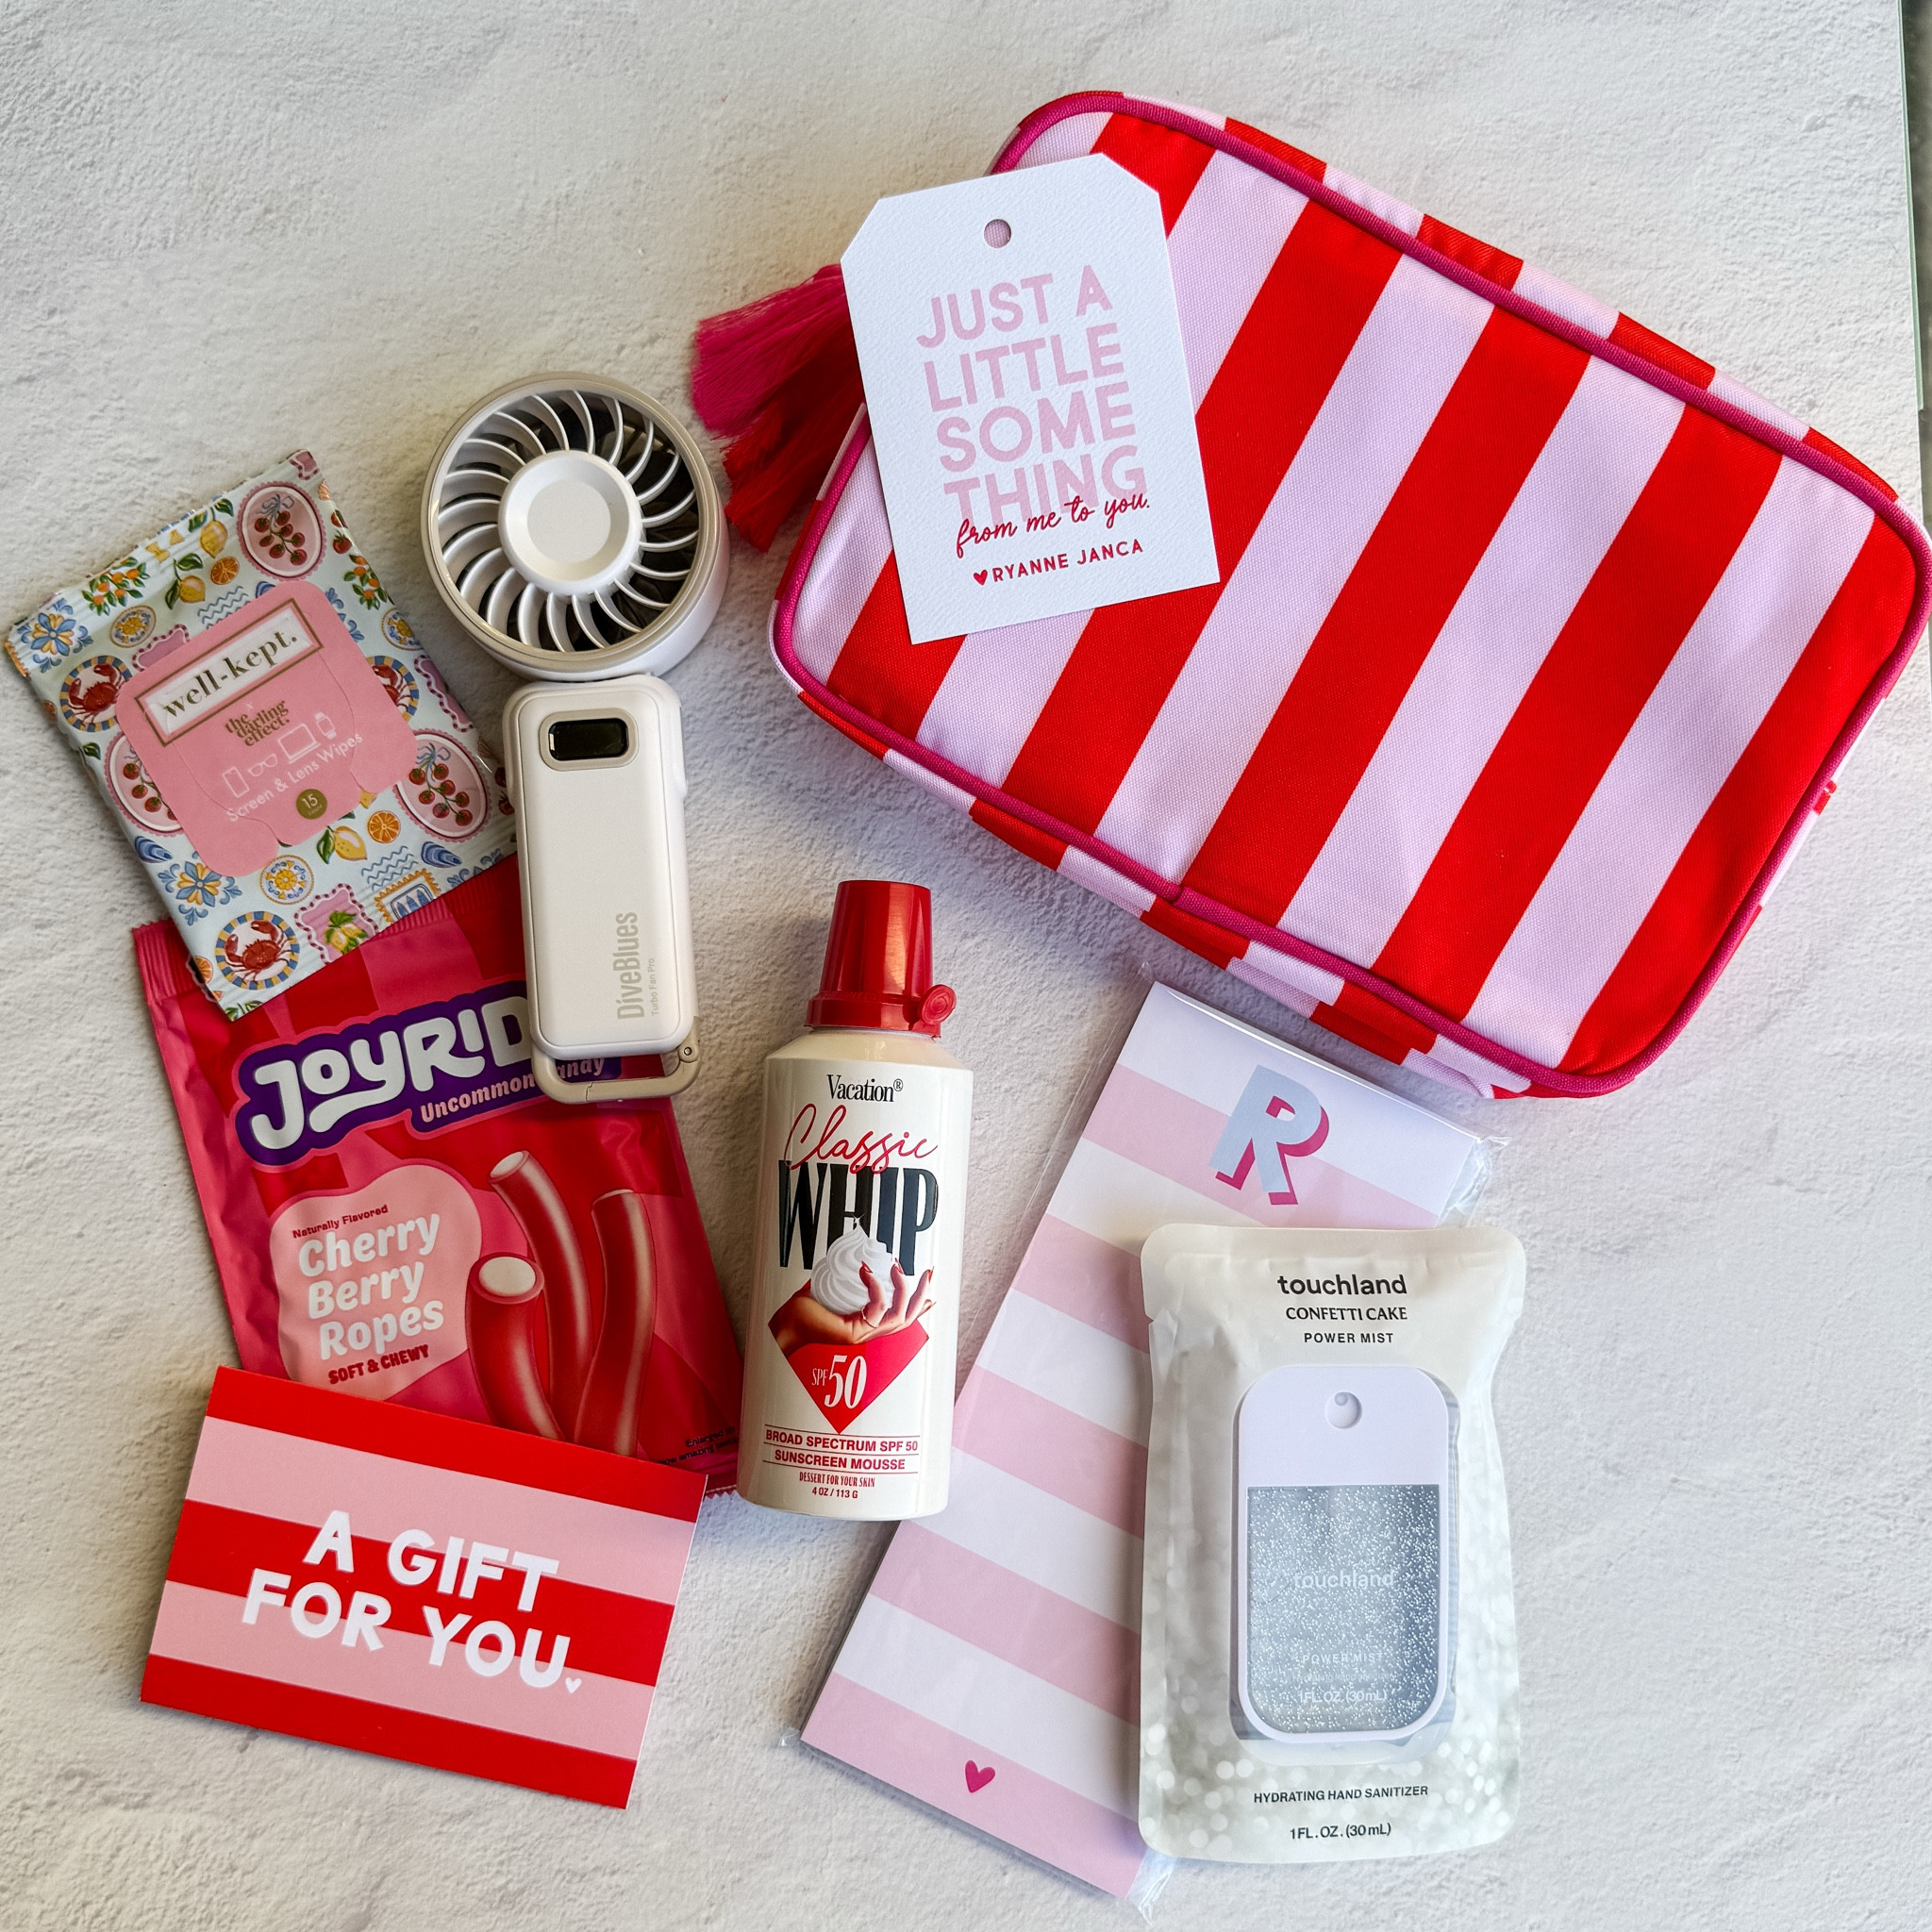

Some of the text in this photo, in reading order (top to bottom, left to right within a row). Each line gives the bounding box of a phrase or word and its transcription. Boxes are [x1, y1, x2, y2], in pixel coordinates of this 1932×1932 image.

[916, 265, 1113, 348] JUST A
[924, 323, 1124, 412] LITTLE
[937, 381, 1136, 472] SOME
[943, 445, 1147, 527] THING
[957, 493, 1150, 558] from me to you.
[992, 539, 1143, 582] RYANNE JANCA
[162, 632, 297, 717] well-kept.
[225, 714, 248, 733] the
[237, 701, 289, 738] darling
[226, 733, 363, 822] Screen & Lens Wipes
[302, 793, 318, 808] 15
[612, 911, 645, 1019] DiveBlues
[650, 991, 659, 1016] Turbo
[251, 995, 532, 1149] JOYRID
[420, 1058, 605, 1123] Uncommon andy
[784, 1103, 938, 1174] Classic
[1208, 1064, 1329, 1206] R
[292, 1204, 389, 1239] Naturally Flavored
[778, 1159, 939, 1275] WHIP
[299, 1213, 440, 1277] Cherry
[308, 1261, 425, 1319] Berry
[1277, 1274, 1407, 1295] touchland
[320, 1300, 444, 1360] Ropes
[1286, 1307, 1407, 1321] CONFETTI CAKE
[1304, 1333, 1393, 1343] POWER MIST
[328, 1344, 429, 1384] SOFT & CHEWY
[811, 1355, 867, 1408] SPF 50
[766, 1429, 918, 1452] BROAD SPECTRUM SPF 50
[774, 1449, 906, 1470] SUNSCREEN MOUSSE
[799, 1472, 875, 1488] DESSERT FOR YOUR SKIN
[811, 1487, 818, 1495] 4
[818, 1487, 829, 1497] OZ
[836, 1489, 850, 1498] 113
[852, 1490, 858, 1499] G
[302, 1509, 559, 1612] A GIFT
[1293, 1570, 1395, 1589] touchland
[242, 1568, 391, 1651] FOR
[1302, 1653, 1383, 1663] POWER MIST
[1254, 1786, 1428, 1803] HYDRATING HAND SANITIZER
